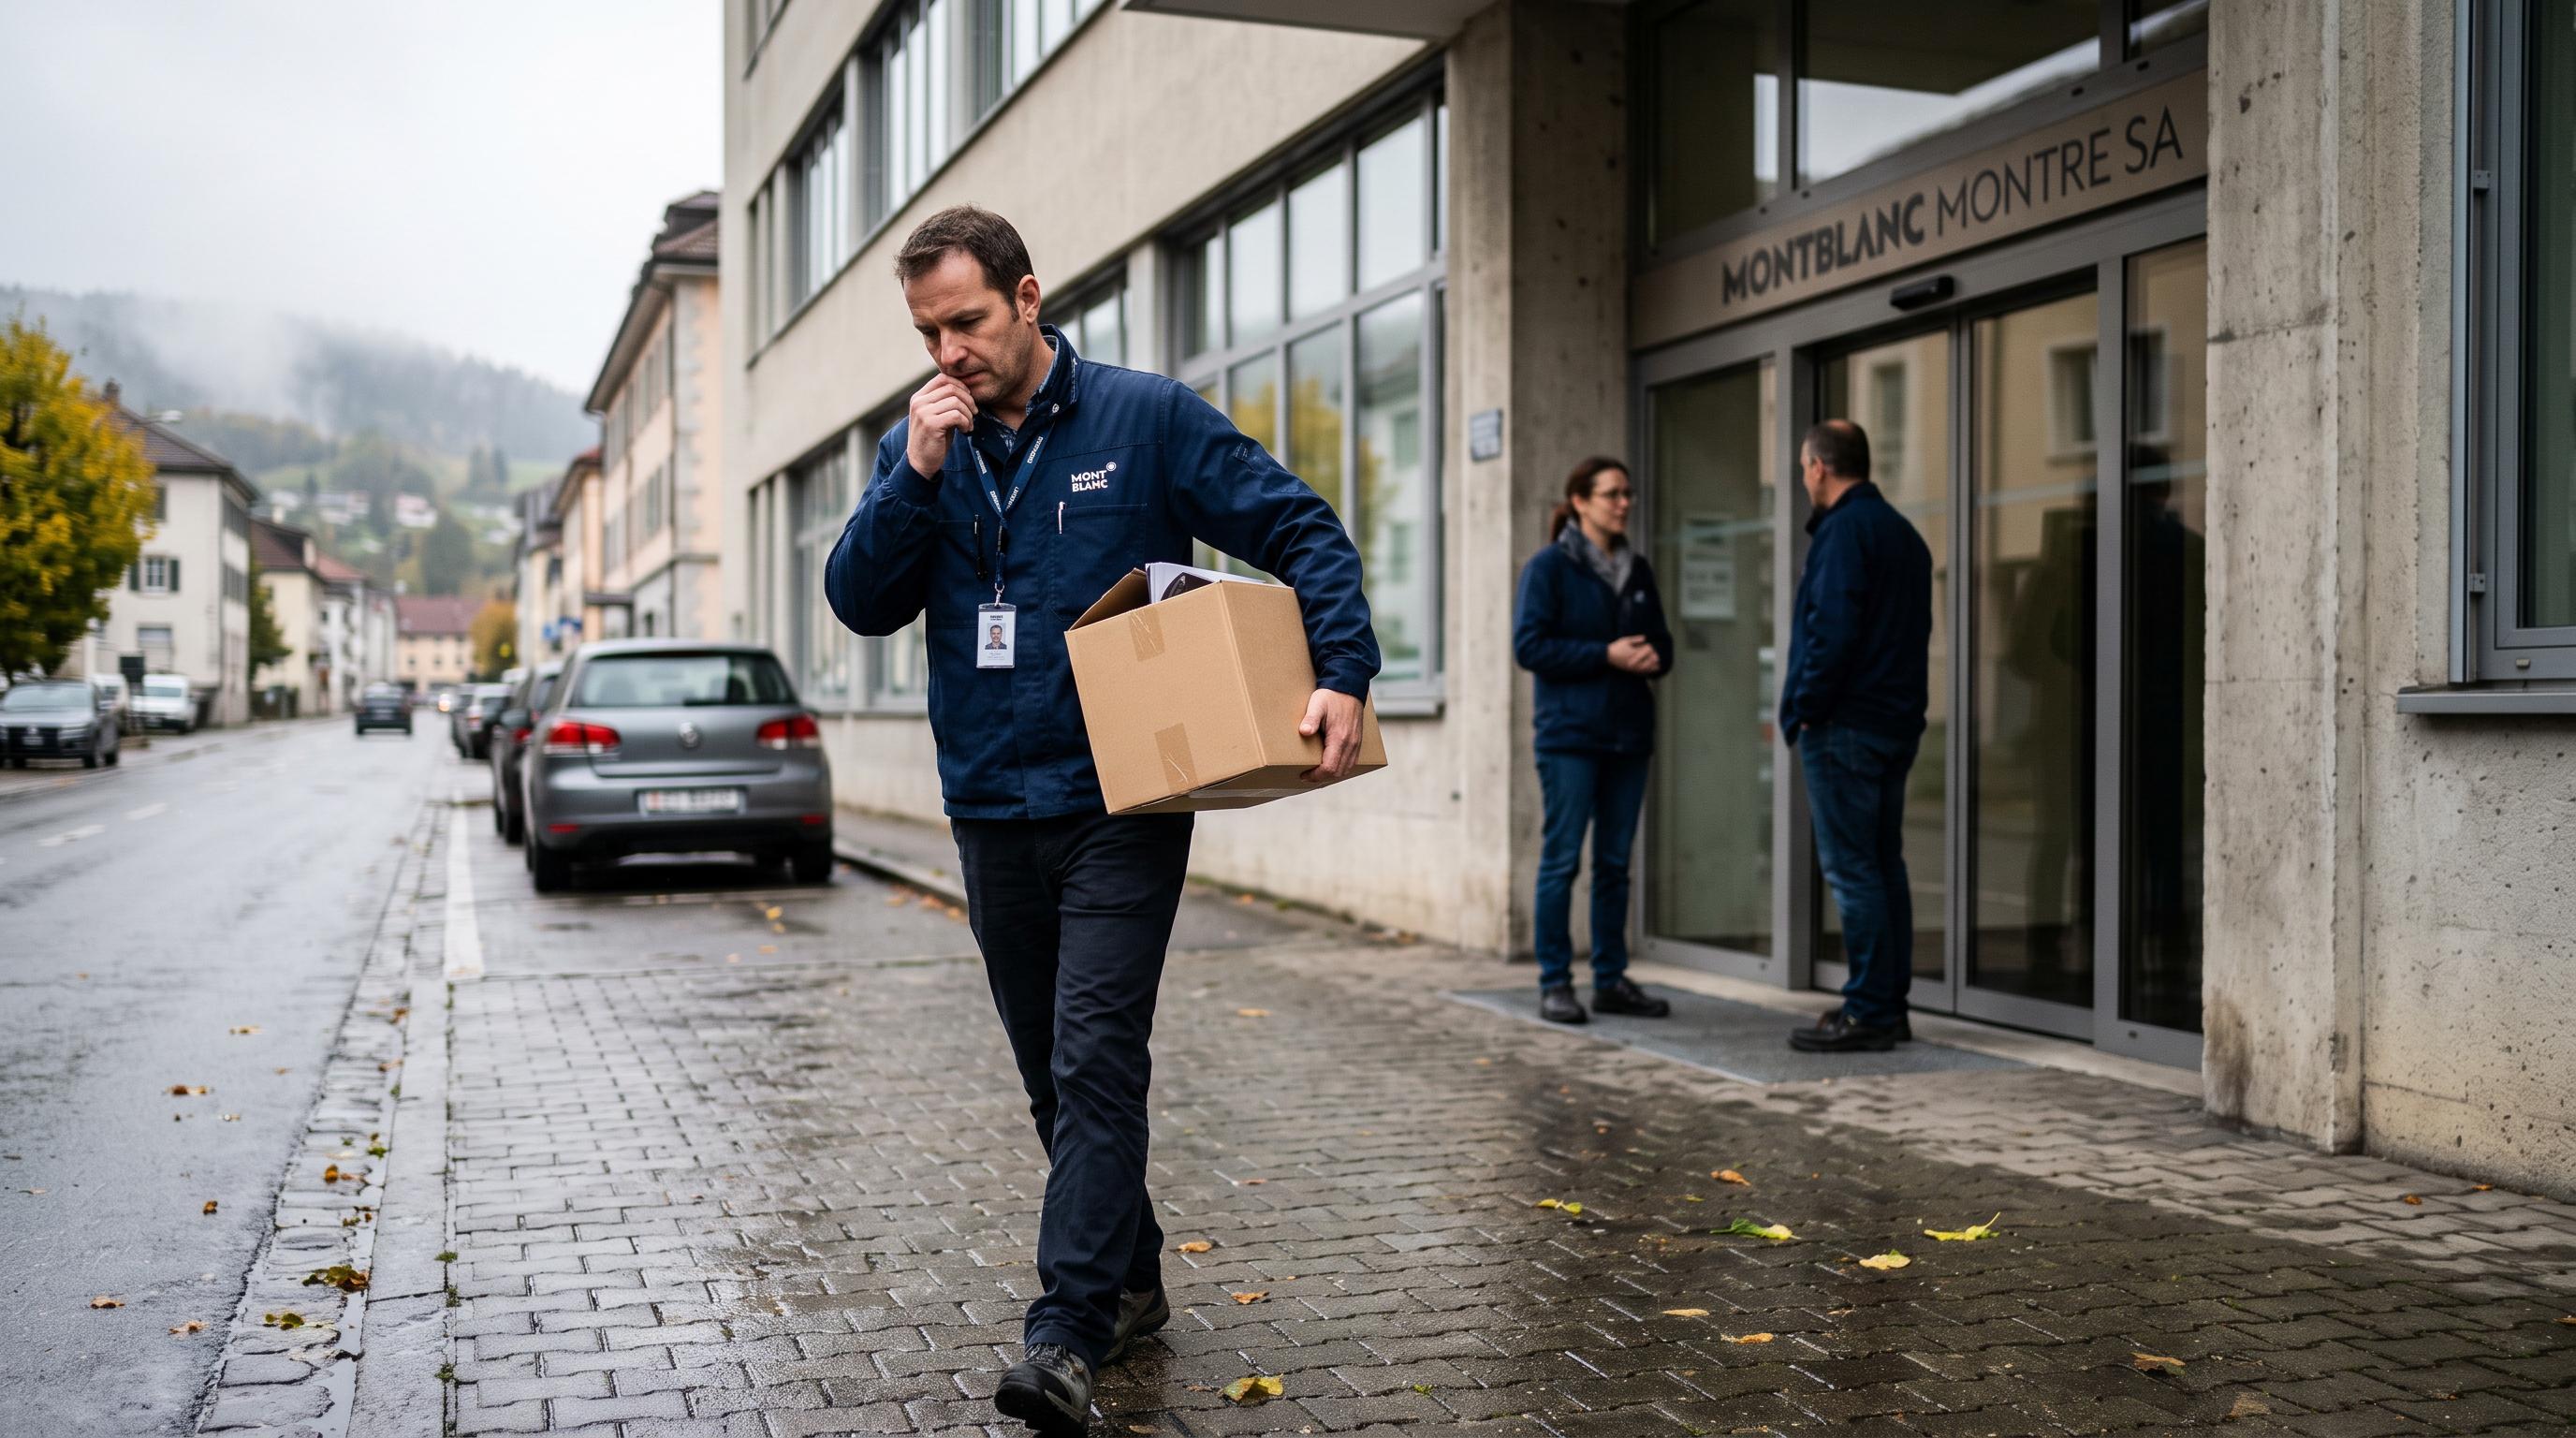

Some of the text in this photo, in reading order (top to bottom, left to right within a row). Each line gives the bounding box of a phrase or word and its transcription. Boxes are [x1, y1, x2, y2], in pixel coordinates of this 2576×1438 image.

[1721, 105, 2184, 306] MONTBLANC MONTRE SA
[1071, 470, 1106, 482] MONT
[1072, 479, 1107, 492] BLANC
